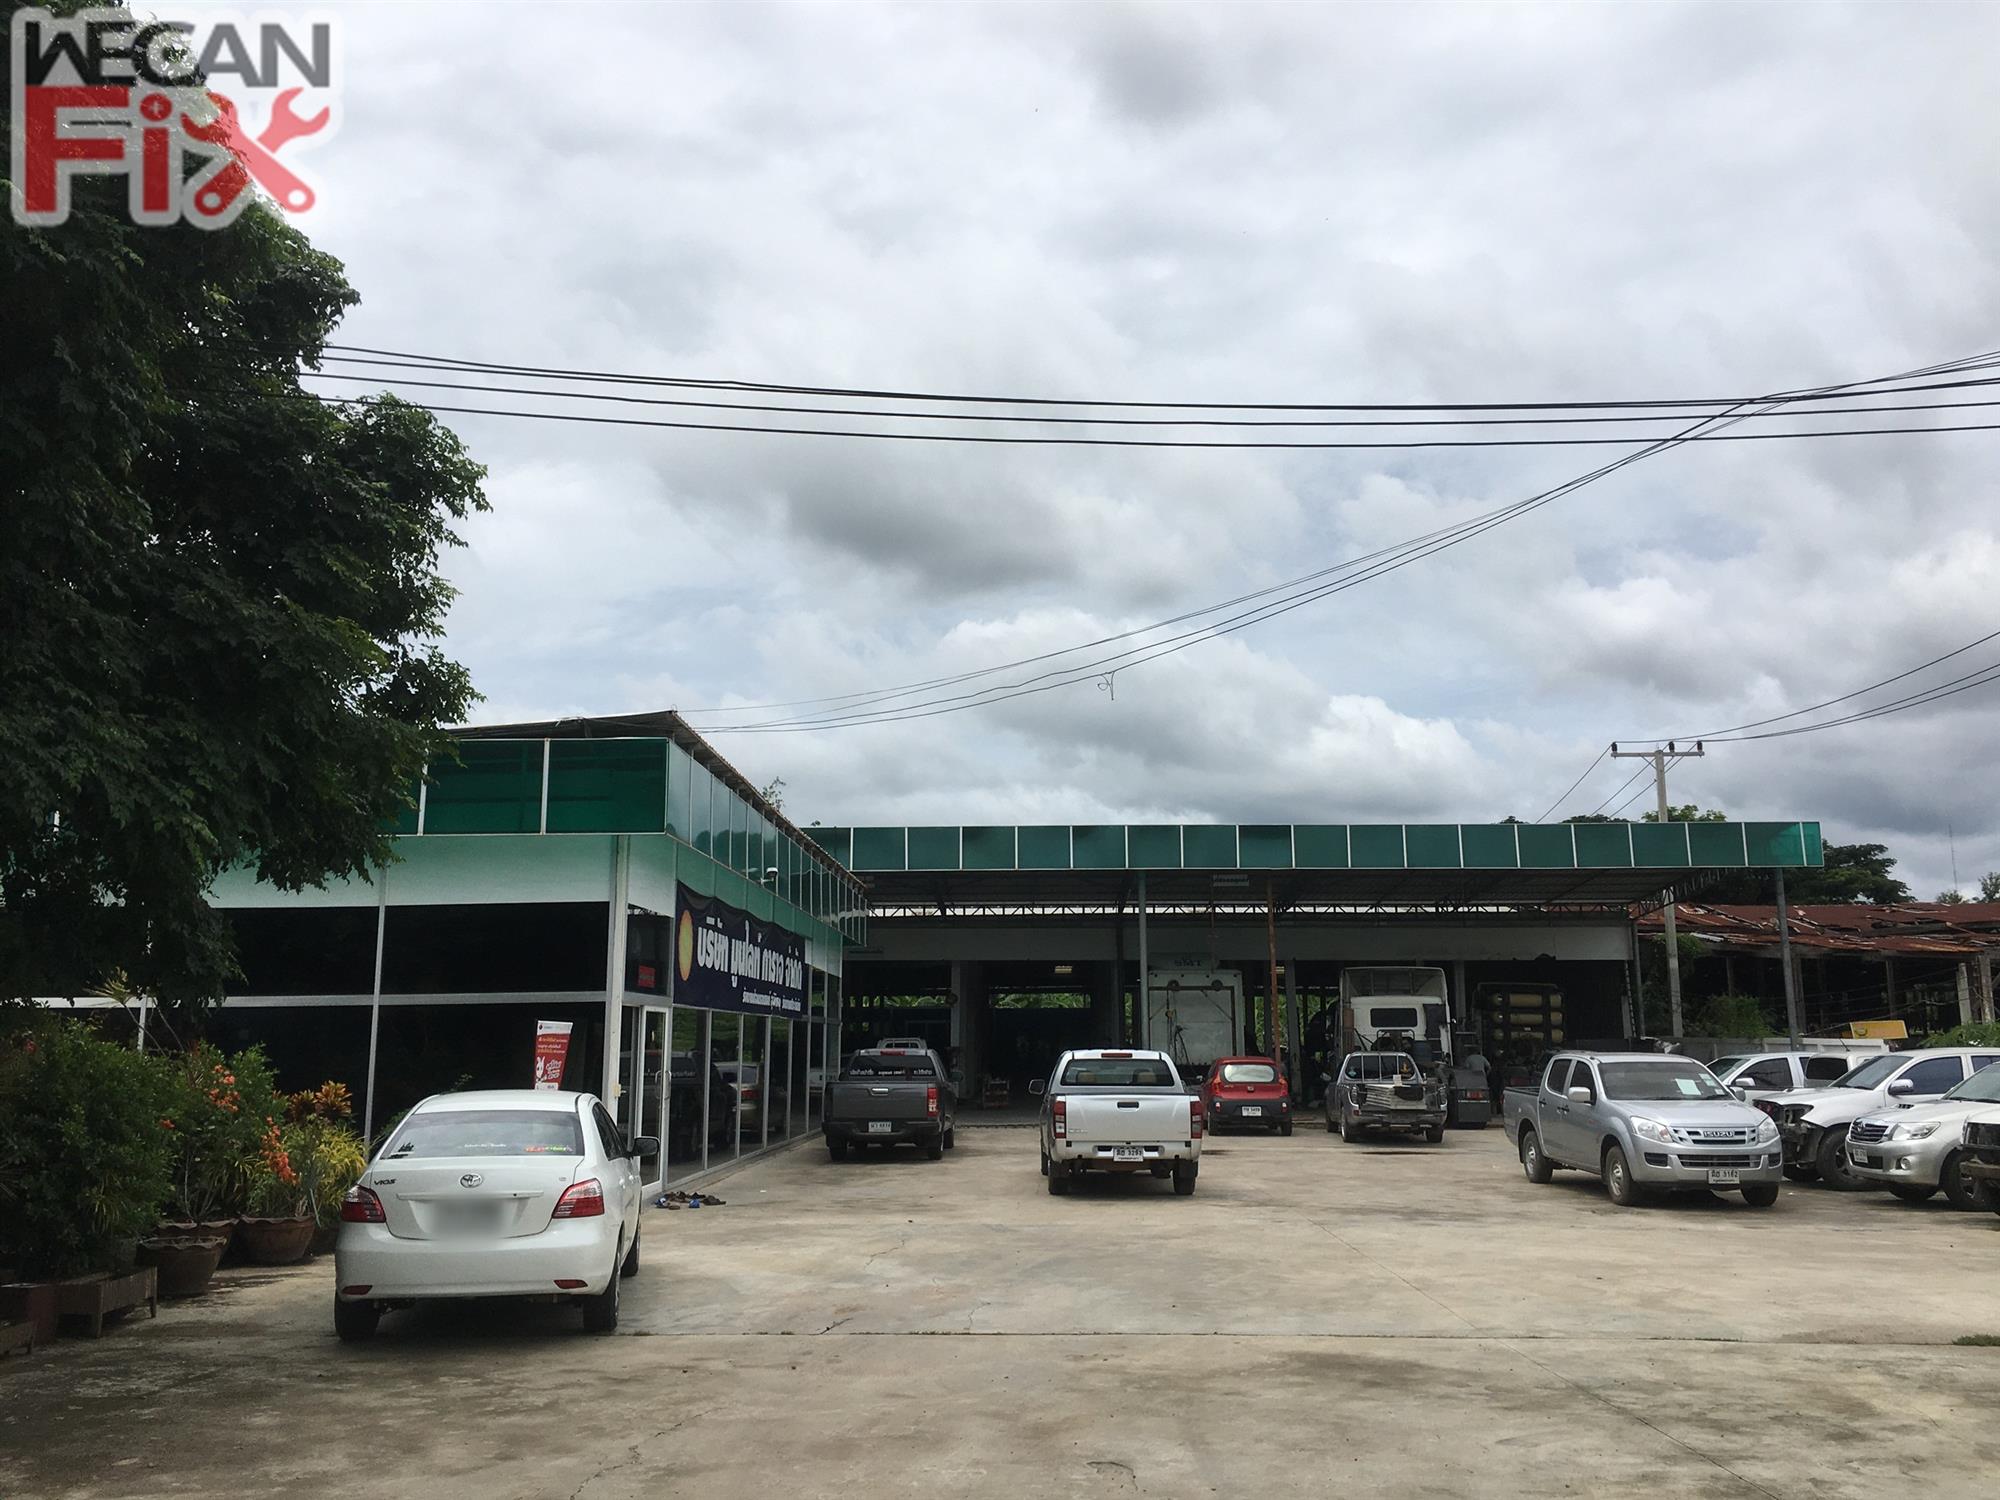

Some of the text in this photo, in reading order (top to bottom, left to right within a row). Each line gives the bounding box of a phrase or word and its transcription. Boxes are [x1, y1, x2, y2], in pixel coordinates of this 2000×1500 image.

[697, 916, 729, 973] บริษัท
[1703, 1130, 1734, 1138] ISUZU
[373, 1178, 397, 1186] VIOS
